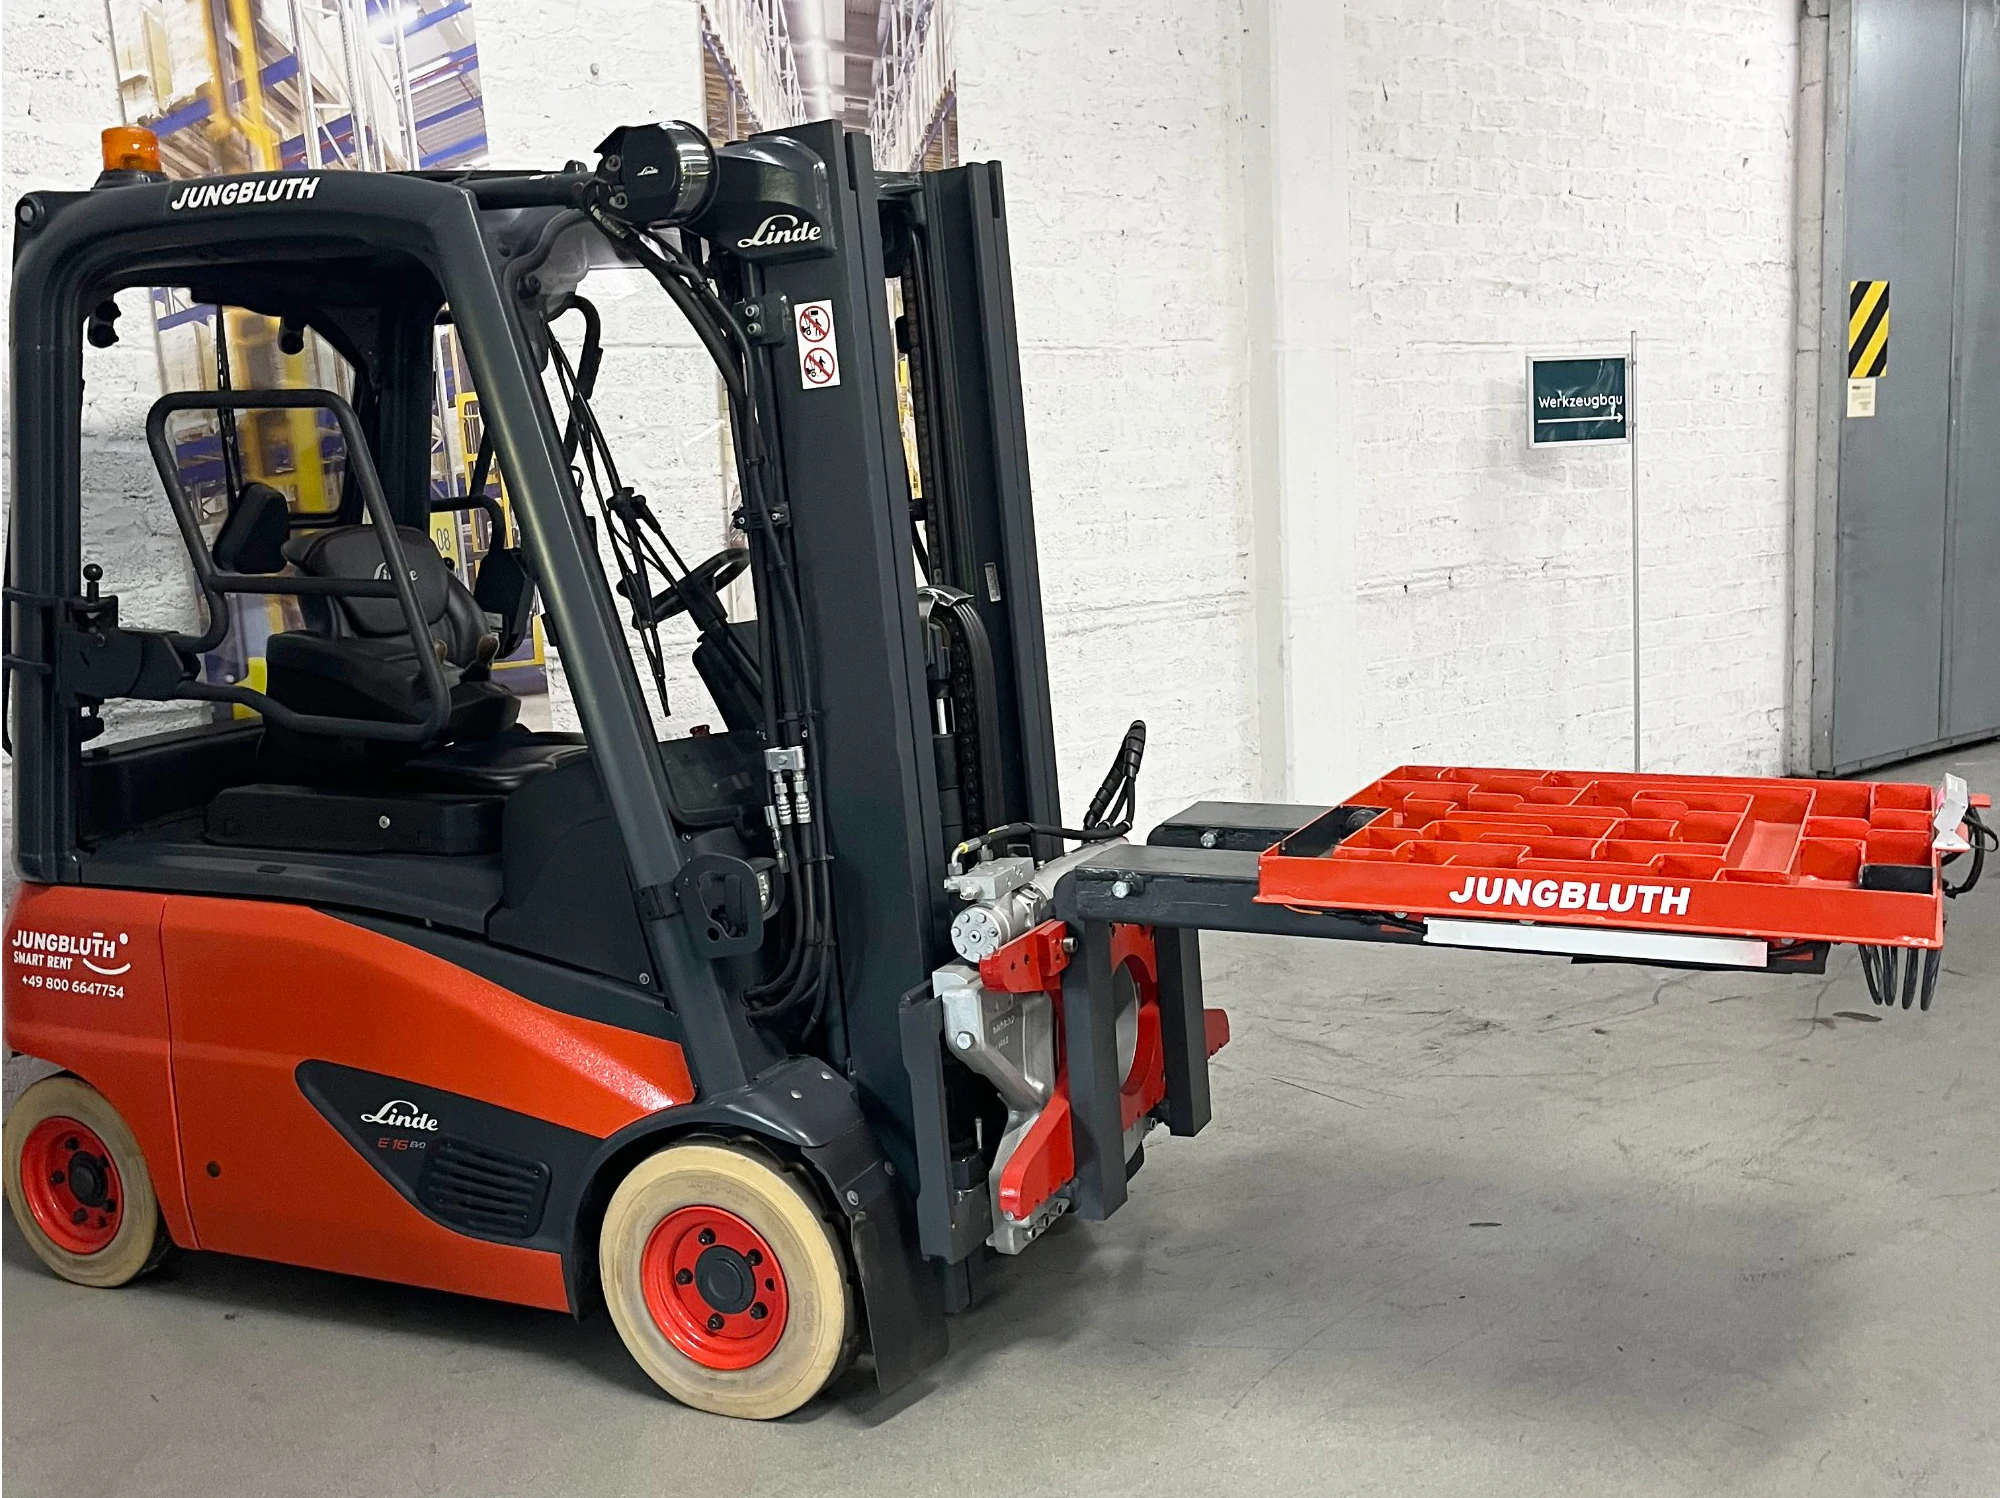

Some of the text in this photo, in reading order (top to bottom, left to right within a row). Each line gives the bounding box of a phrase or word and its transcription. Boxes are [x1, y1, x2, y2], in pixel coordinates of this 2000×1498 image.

[171, 177, 320, 210] JUNGBLUTH
[737, 214, 822, 248] Linde
[1538, 393, 1623, 409] Werkzeugbau
[436, 527, 451, 551] 08
[1448, 876, 1691, 915] JUNGBLUTH
[12, 929, 116, 958] JUNGBLUTH
[13, 950, 73, 970] SMART RENT
[22, 975, 125, 998] +49 800 6647754
[360, 1100, 439, 1131] Linde
[377, 1137, 391, 1148] E
